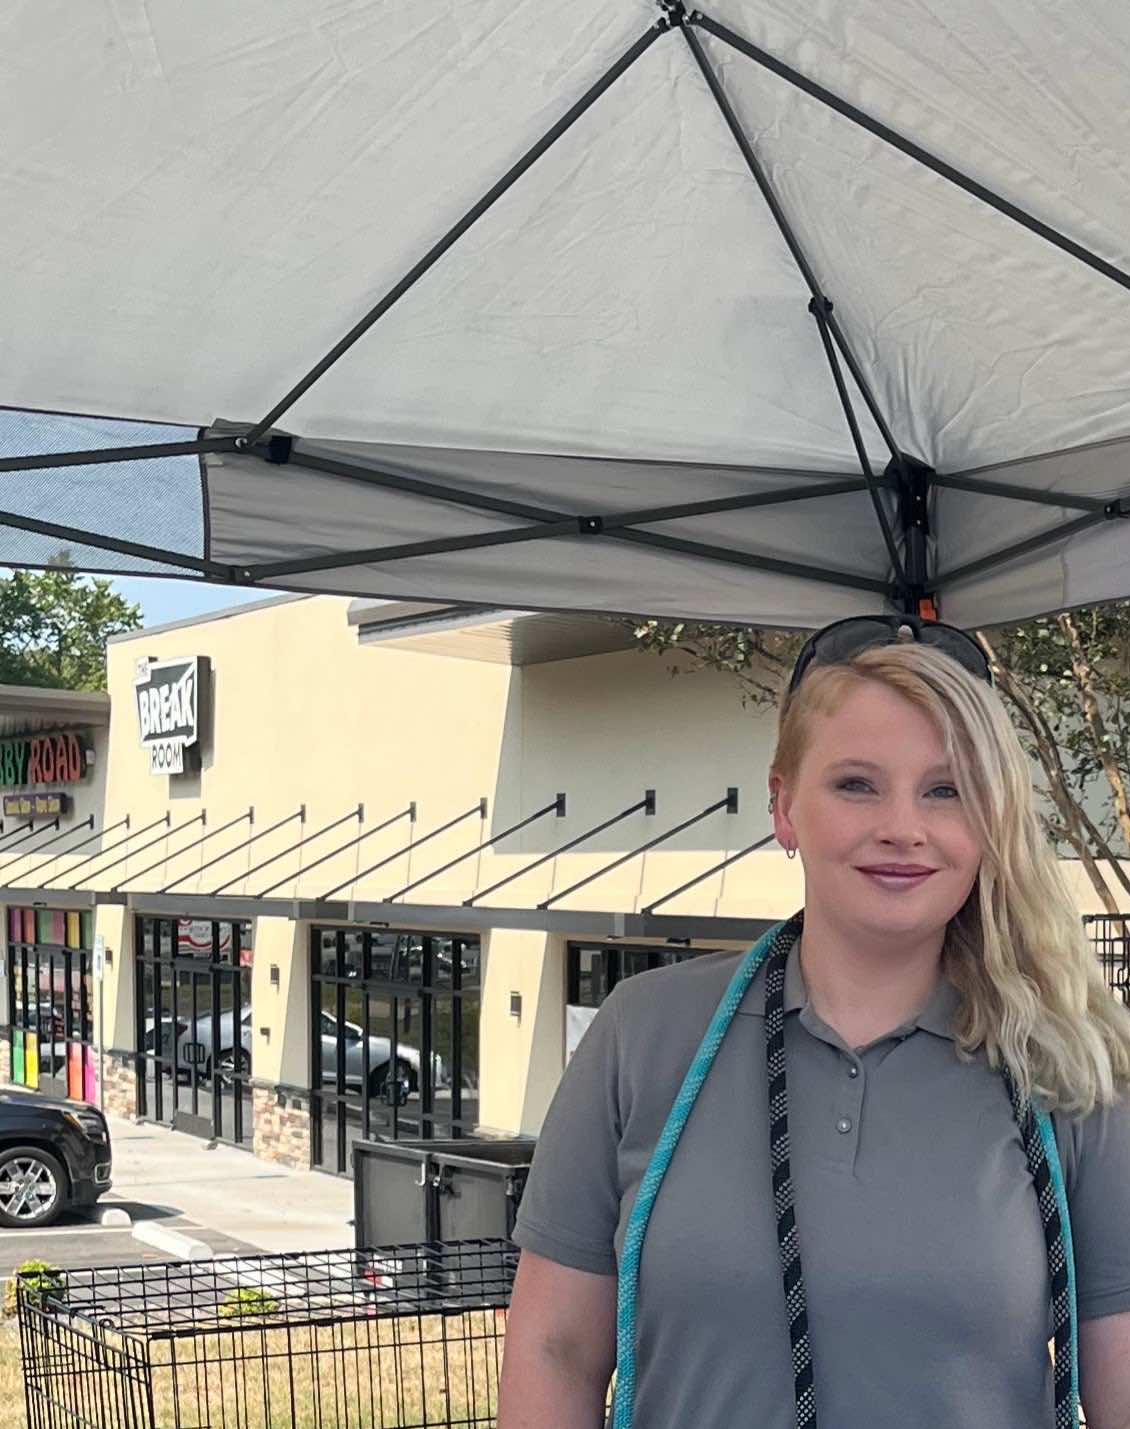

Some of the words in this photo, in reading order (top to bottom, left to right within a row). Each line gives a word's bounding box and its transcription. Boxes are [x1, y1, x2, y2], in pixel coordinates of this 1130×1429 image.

[139, 679, 195, 736] BREAK
[28, 736, 81, 785] ROAD
[152, 743, 183, 769] ROOM
